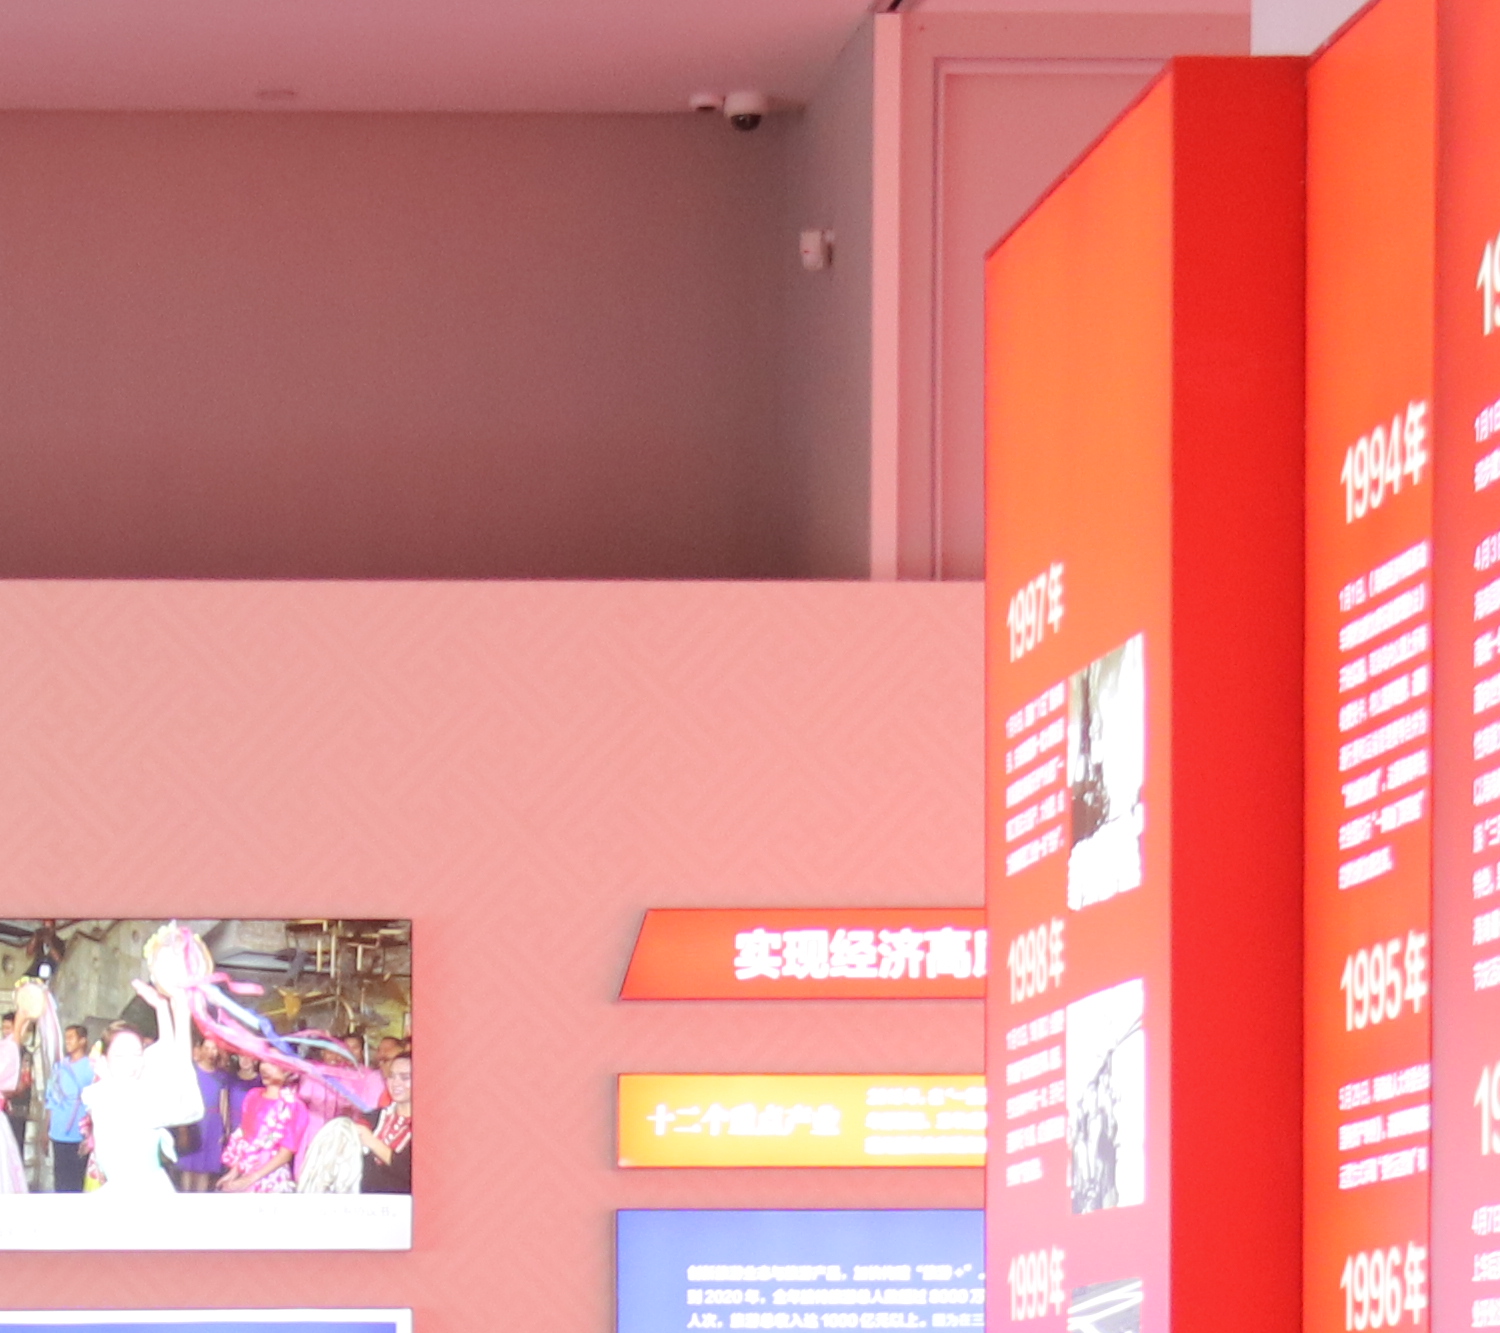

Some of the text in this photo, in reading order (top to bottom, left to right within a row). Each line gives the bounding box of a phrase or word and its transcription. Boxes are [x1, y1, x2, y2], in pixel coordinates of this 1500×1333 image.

[1341, 402, 1427, 523] 1994年
[1008, 564, 1063, 661] 1997年
[1008, 919, 1064, 1003] 1998年
[1341, 931, 1428, 1031] 1995年
[1008, 1246, 1068, 1320] 1999年
[1341, 1241, 1427, 1330] 1996年
